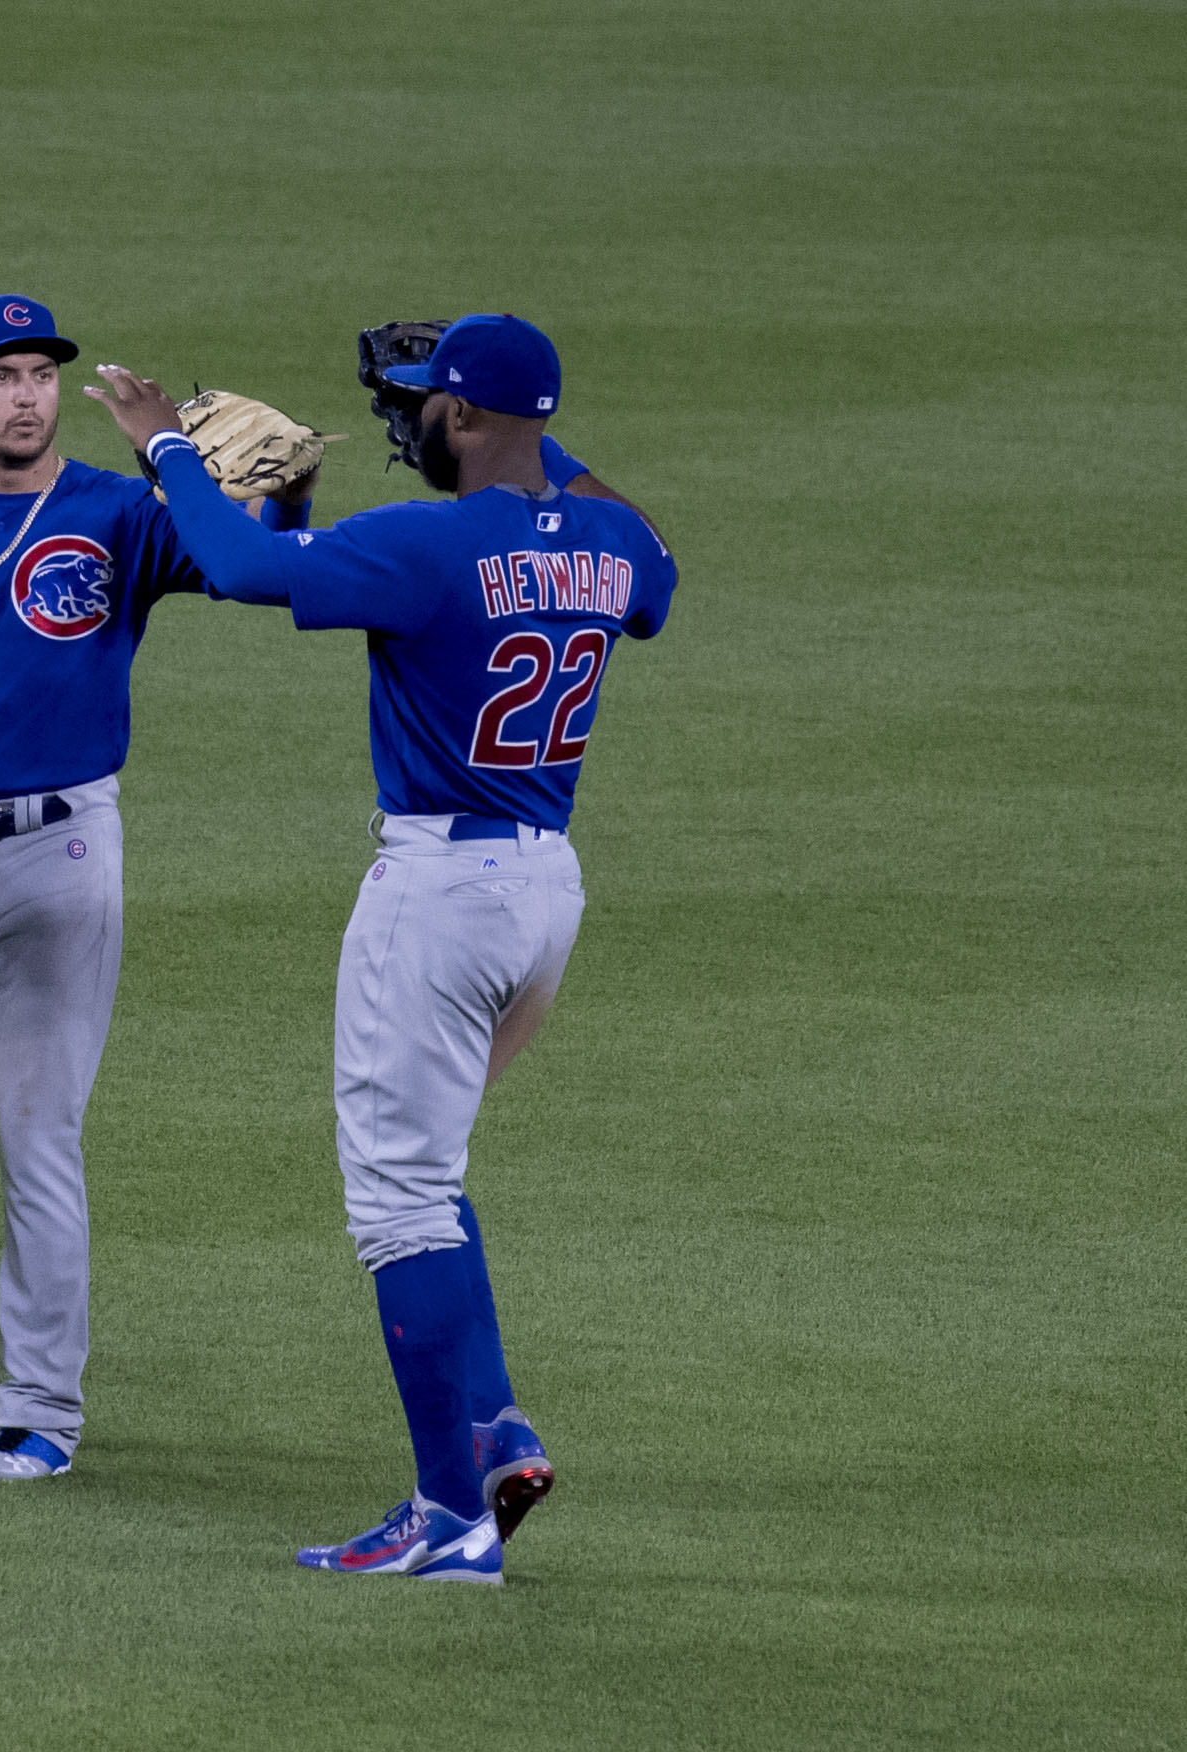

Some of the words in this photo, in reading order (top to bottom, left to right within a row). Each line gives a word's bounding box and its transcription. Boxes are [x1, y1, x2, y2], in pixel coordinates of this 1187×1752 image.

[3, 302, 32, 327] C
[477, 550, 633, 619] HEYWARD
[468, 629, 607, 769] 22
